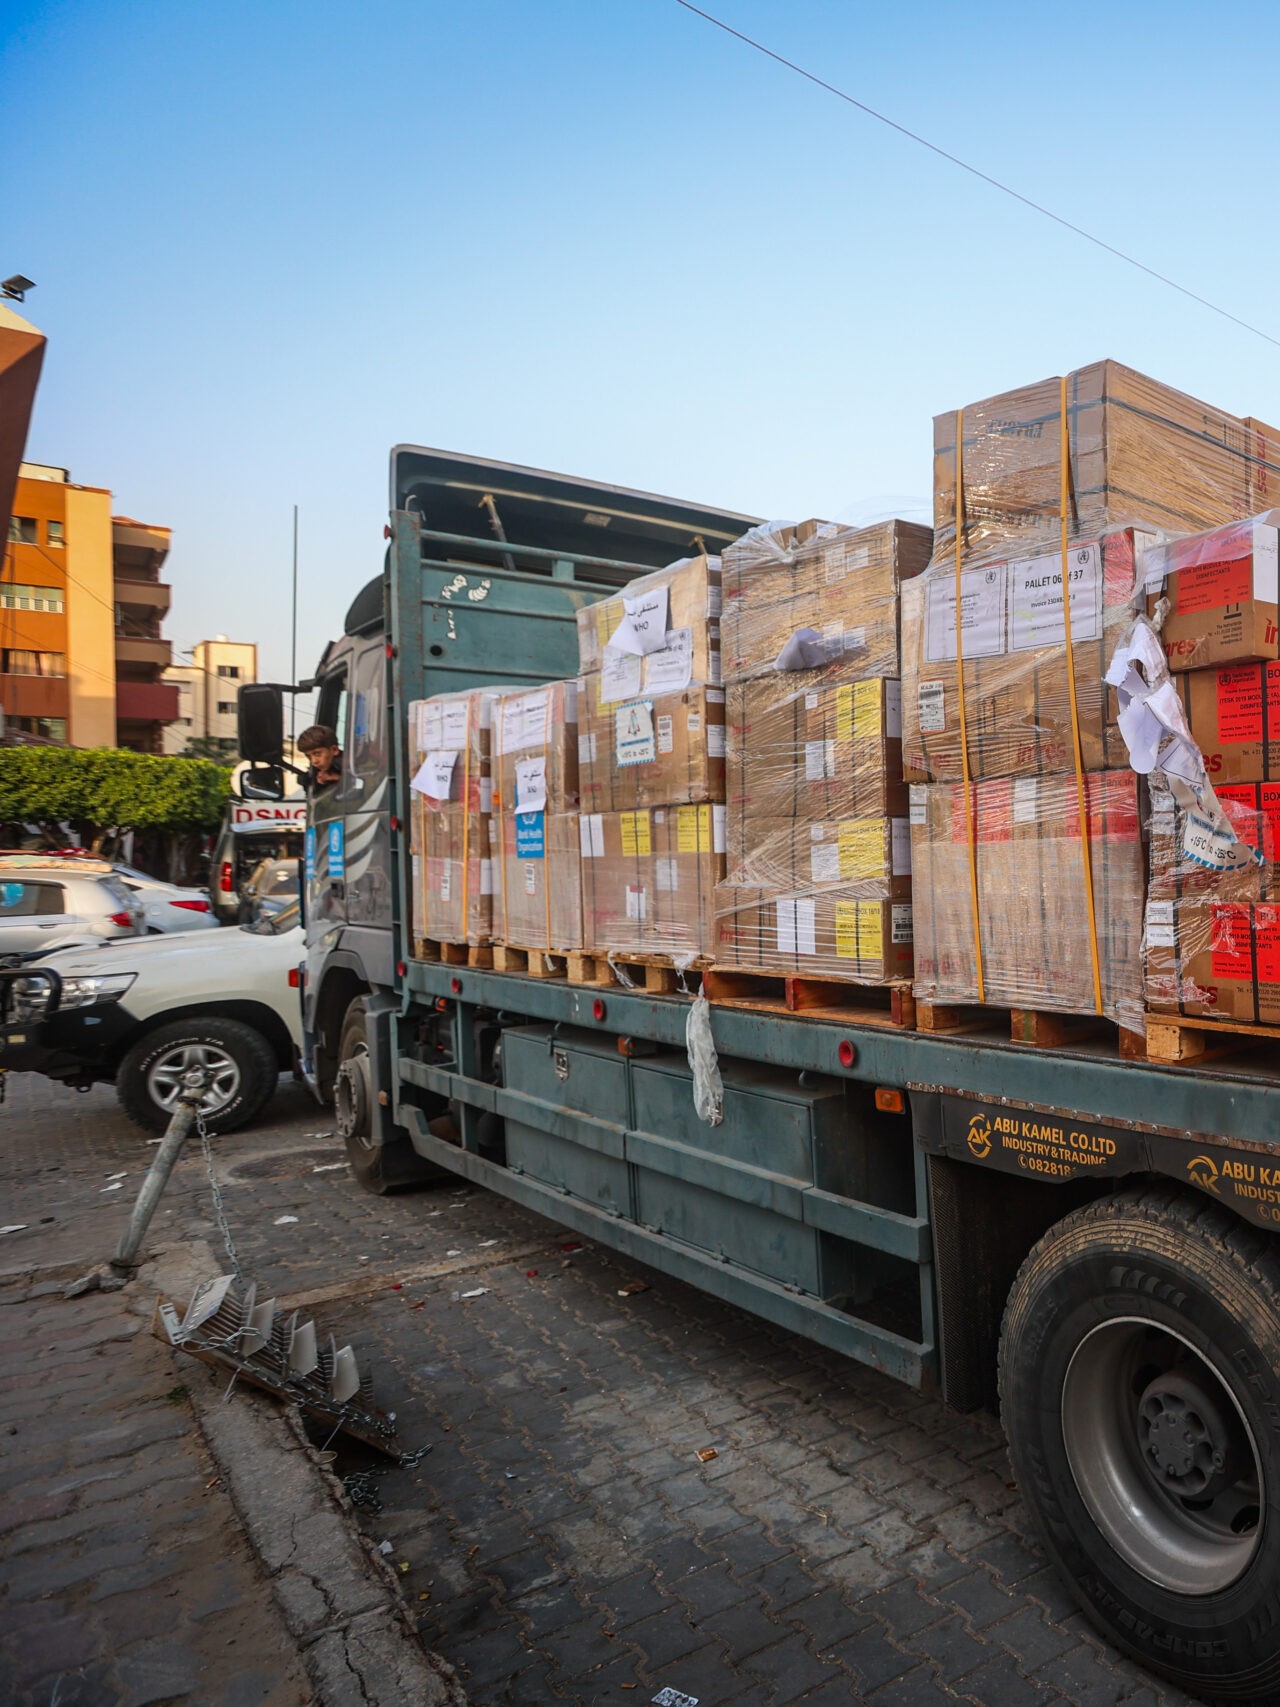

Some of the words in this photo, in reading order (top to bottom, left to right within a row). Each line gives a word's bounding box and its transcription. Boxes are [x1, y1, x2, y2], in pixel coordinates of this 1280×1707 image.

[1024, 576, 1051, 590] PALLET
[1052, 573, 1063, 584] 06
[1073, 570, 1084, 581] 37
[967, 1128, 992, 1147] AK
[994, 1117, 1019, 1135] ABU
[1022, 1122, 1066, 1145] KAMEL
[1070, 1132, 1116, 1155] CO.LTD
[1221, 1160, 1255, 1182] ABU
